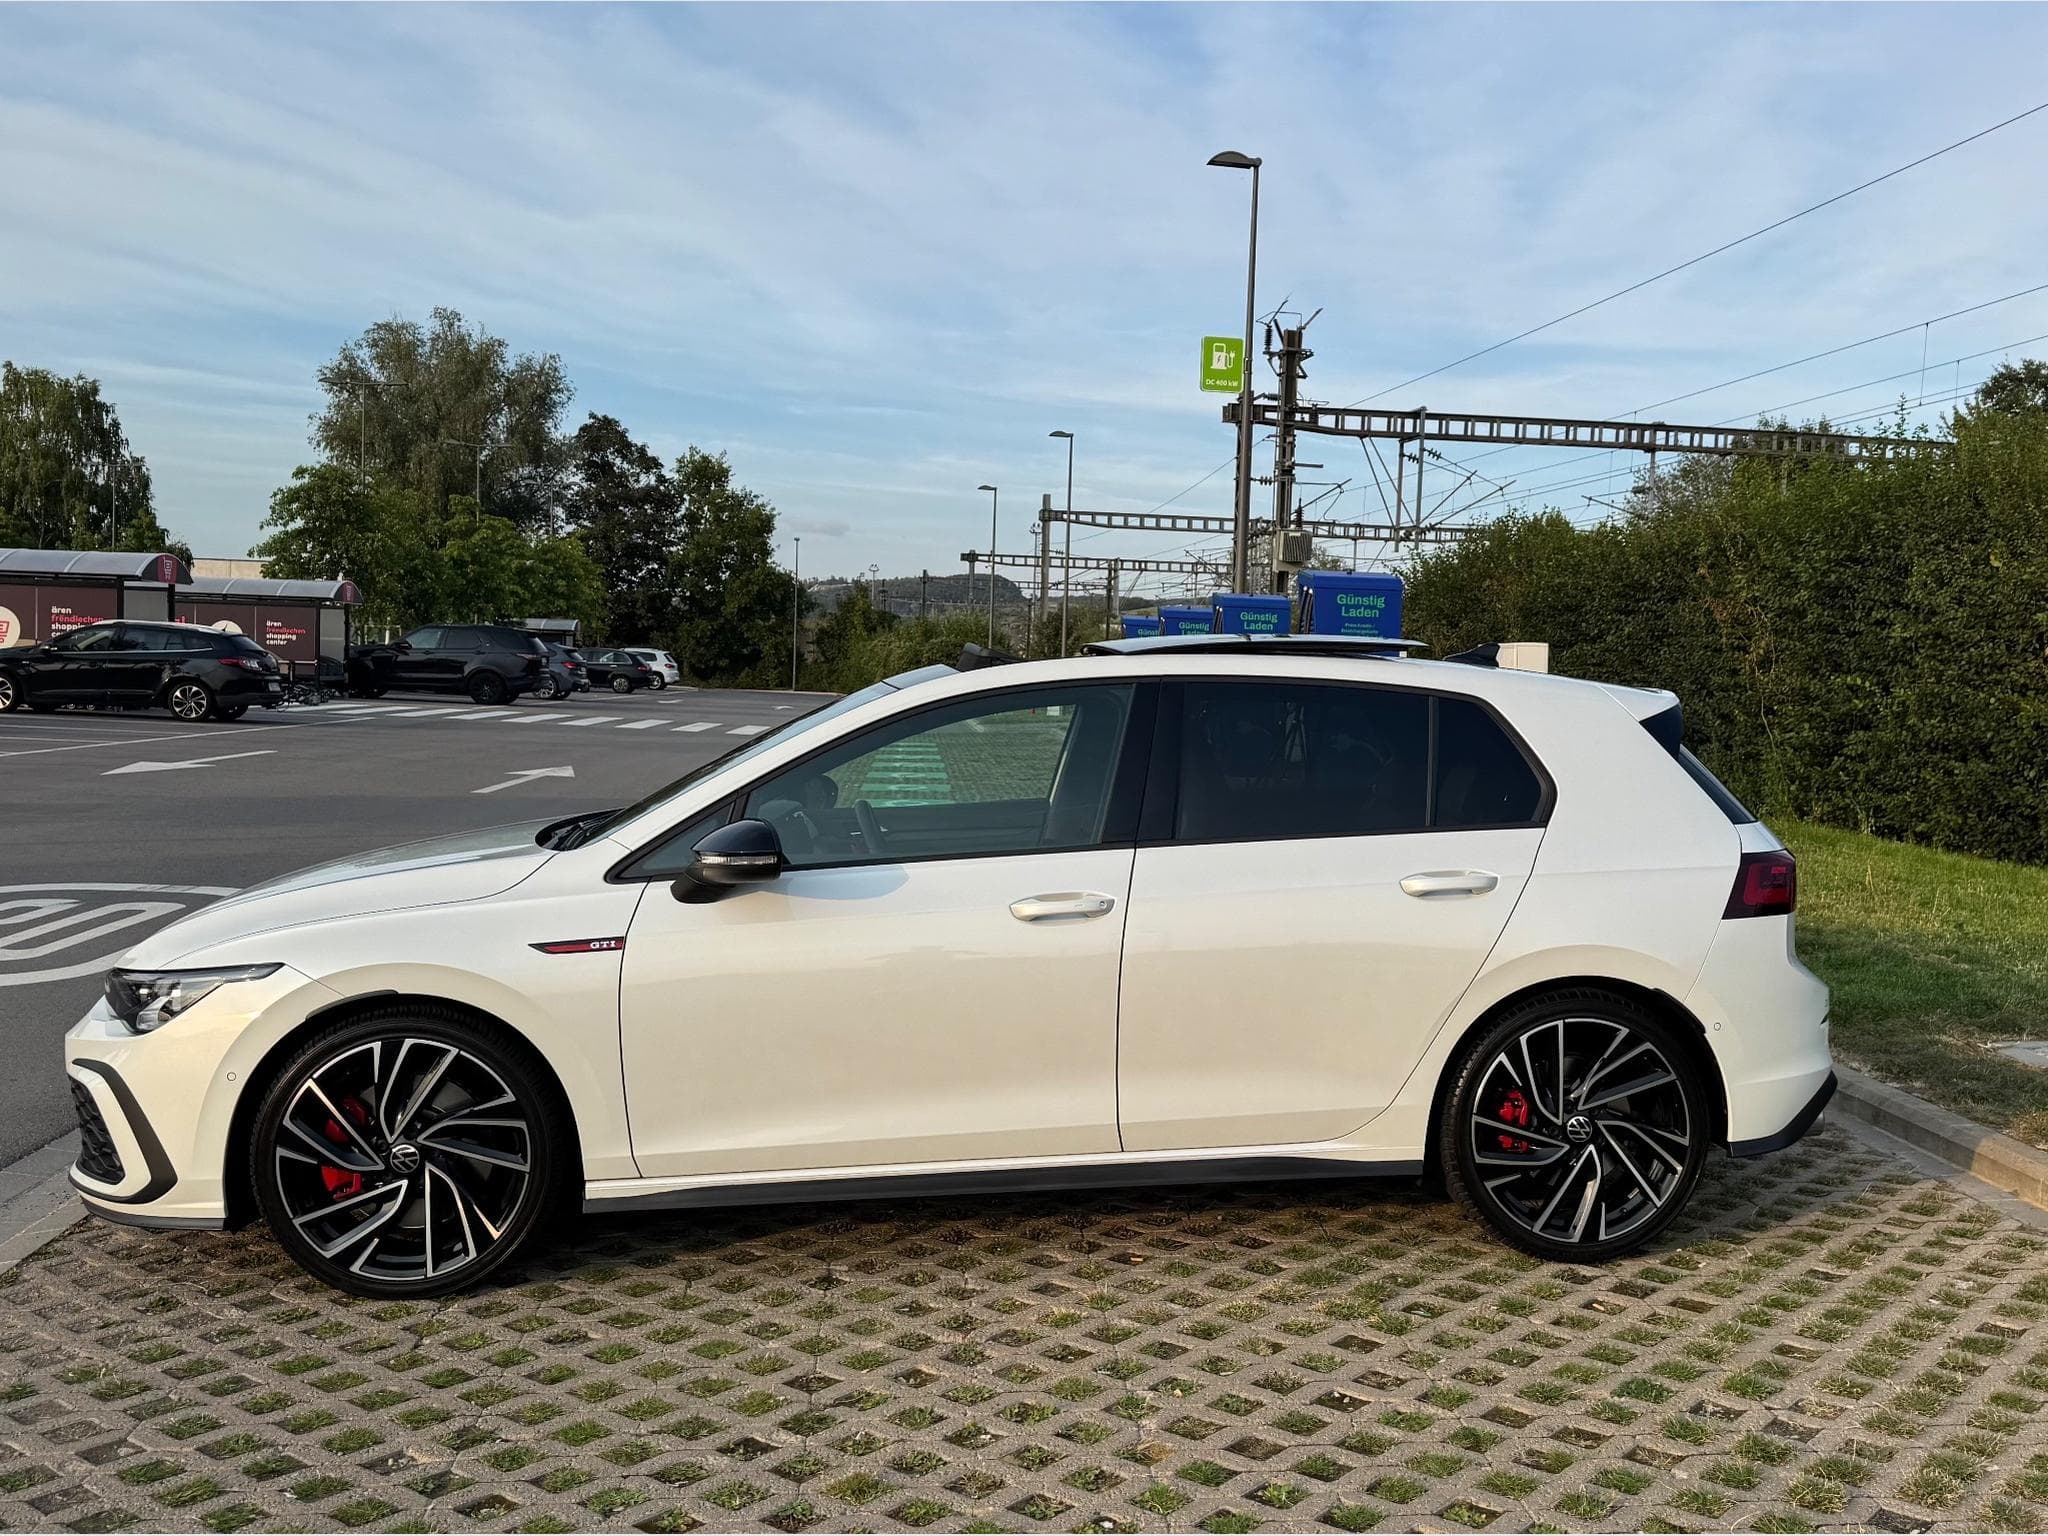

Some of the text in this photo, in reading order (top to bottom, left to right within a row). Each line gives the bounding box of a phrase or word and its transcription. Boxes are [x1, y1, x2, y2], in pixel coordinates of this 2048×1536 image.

[1337, 594, 1386, 608] Günstig
[51, 605, 72, 614] ären
[1341, 606, 1380, 617] Laden
[1240, 611, 1278, 623] Günstig
[1178, 621, 1210, 632] Günstig
[1244, 621, 1274, 630] Laden
[590, 940, 616, 949] GTI
